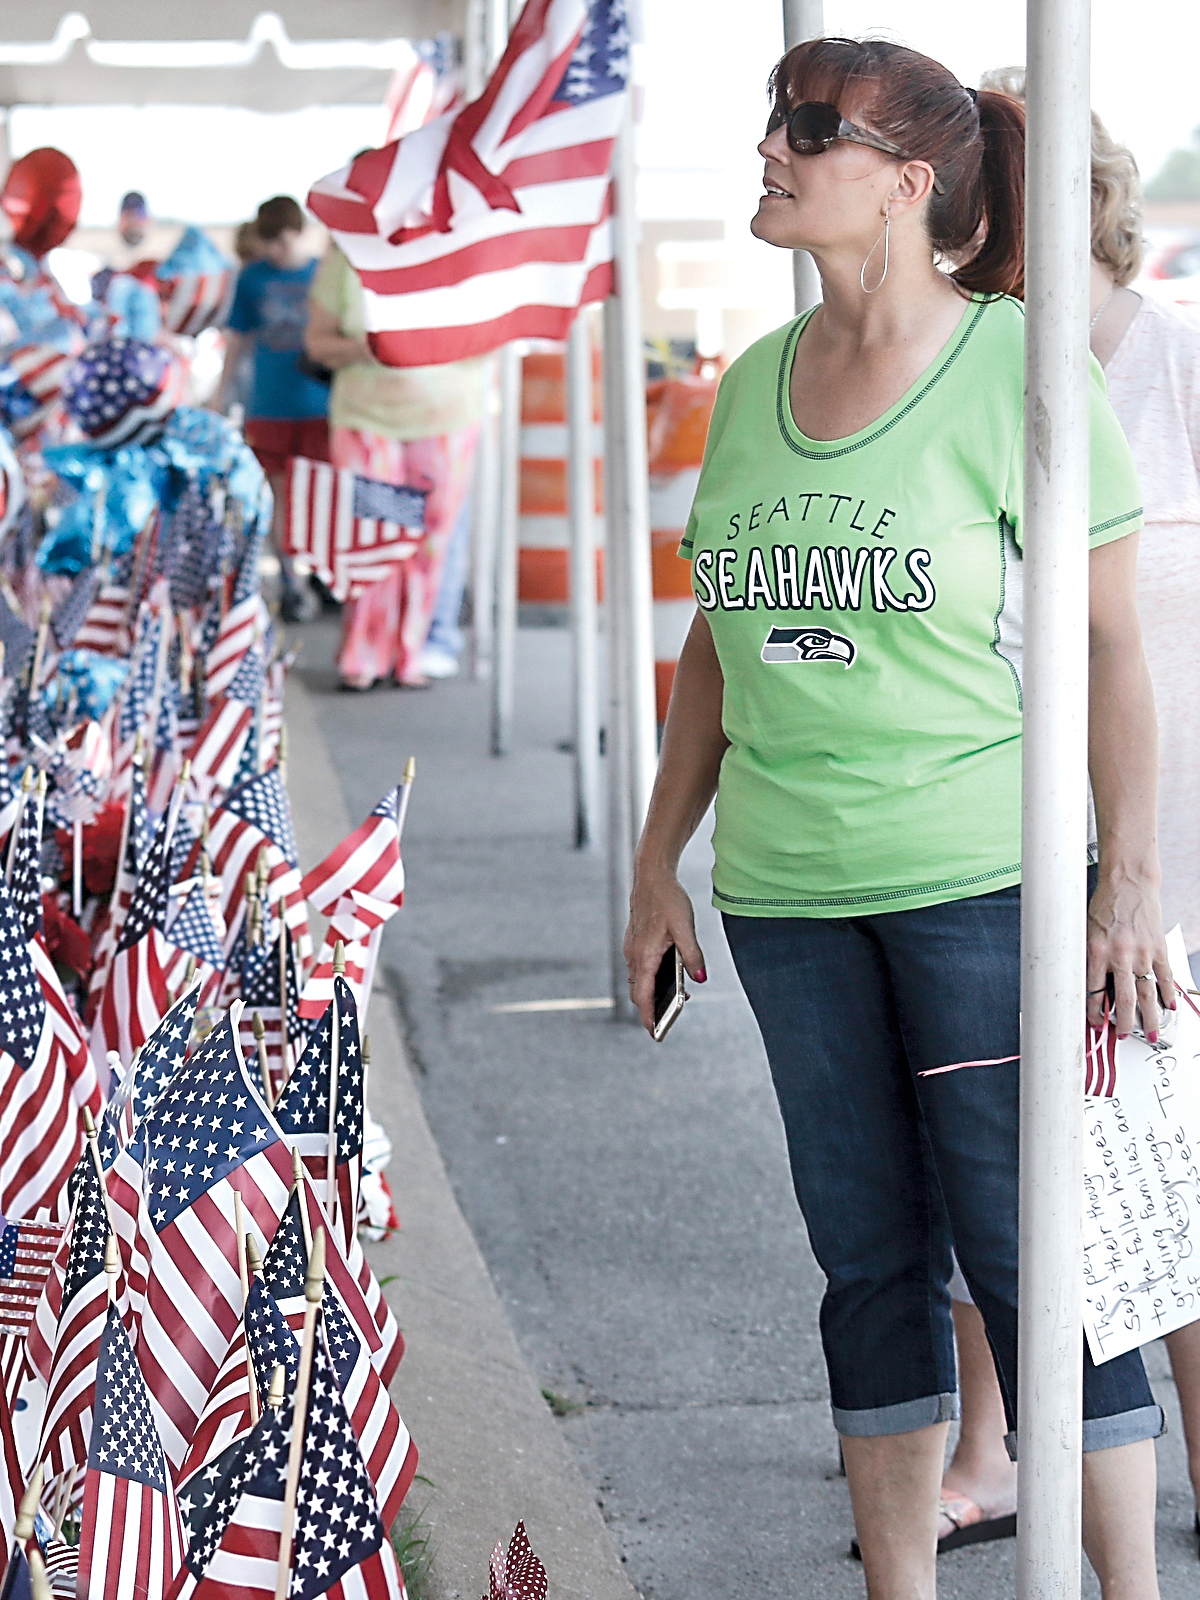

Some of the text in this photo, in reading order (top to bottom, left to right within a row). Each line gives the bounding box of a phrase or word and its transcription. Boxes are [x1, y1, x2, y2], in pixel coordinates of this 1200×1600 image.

[726, 492, 897, 541] SEATTLE
[694, 544, 937, 613] SEAHAWKS
[1089, 1120, 1125, 1197] heroes,
[1103, 1097, 1195, 1309] grieving families, and
[1118, 1199, 1144, 1256] fallen
[1099, 1225, 1125, 1274] their
[1137, 1259, 1158, 1296] the
[1093, 1294, 1114, 1356] The
[1150, 1297, 1167, 1328] to
